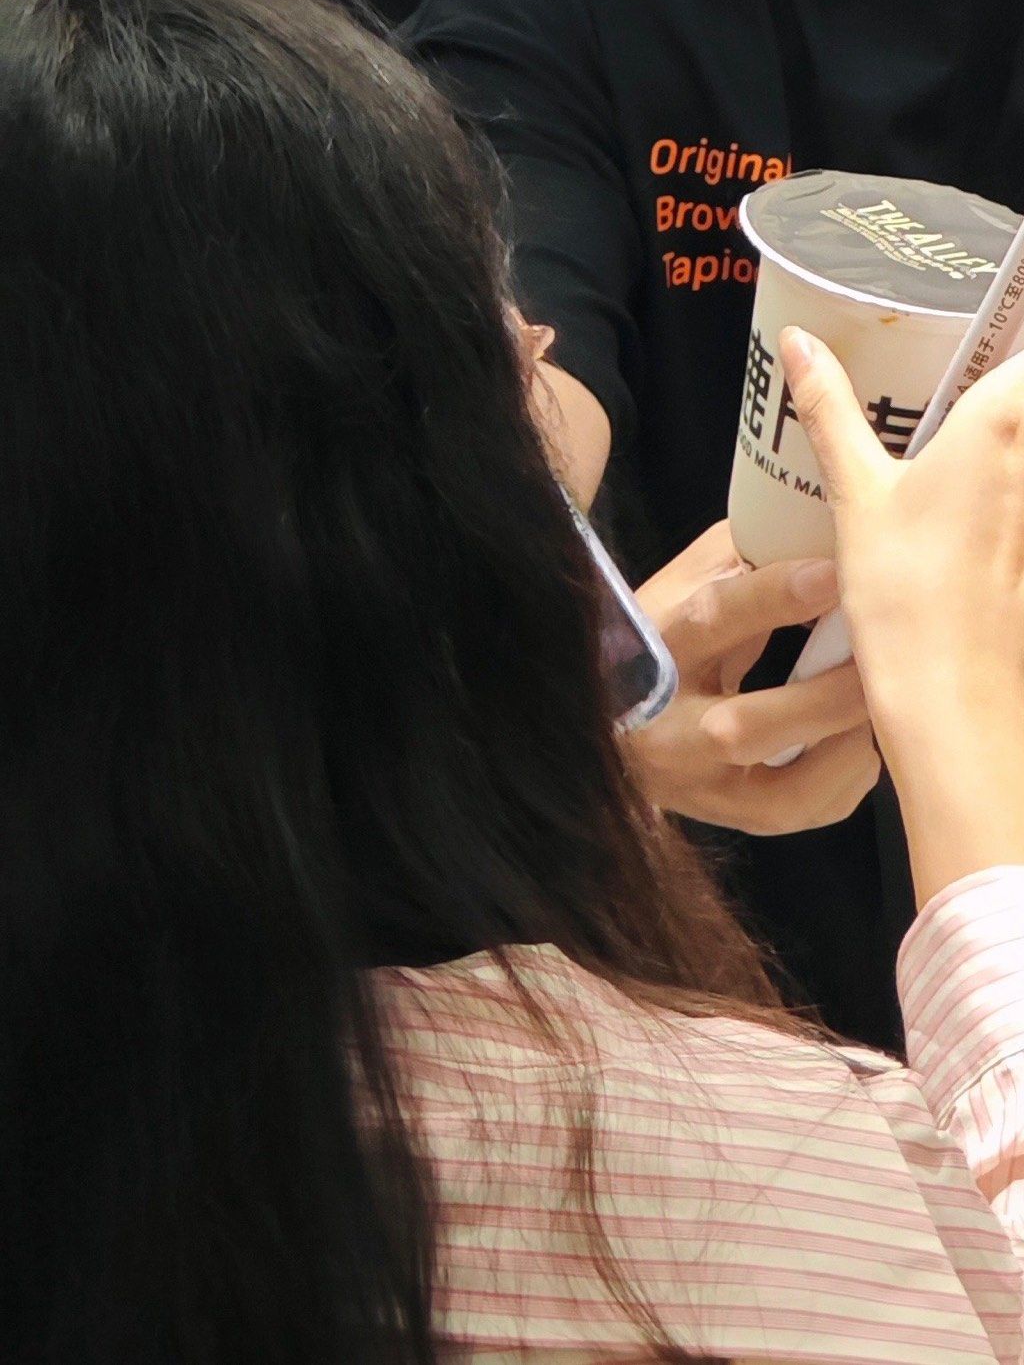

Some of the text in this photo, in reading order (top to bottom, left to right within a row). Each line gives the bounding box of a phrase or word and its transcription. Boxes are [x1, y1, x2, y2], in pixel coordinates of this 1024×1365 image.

[650, 137, 792, 185] Original
[856, 199, 926, 233] THE
[903, 233, 1001, 277] ALLEY
[661, 248, 760, 291] Tapio
[754, 449, 790, 486] MILK
[793, 475, 828, 502] MA
